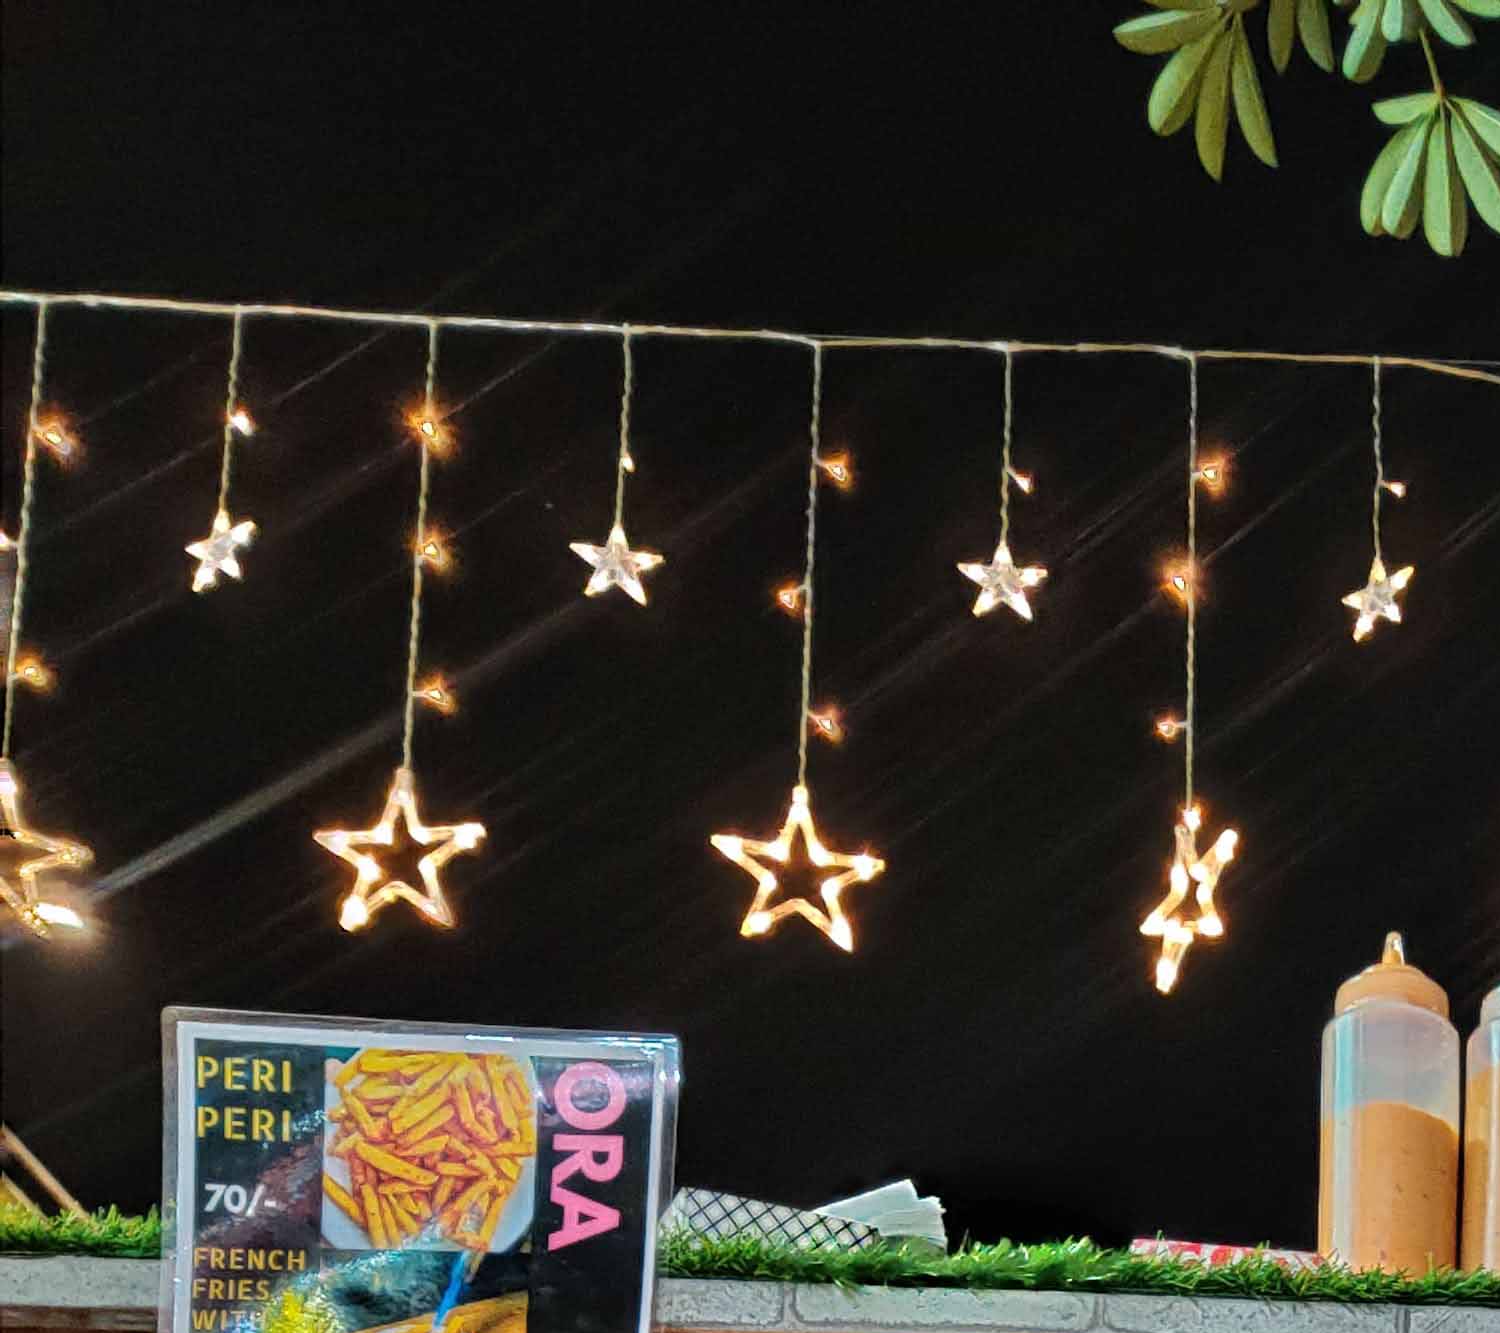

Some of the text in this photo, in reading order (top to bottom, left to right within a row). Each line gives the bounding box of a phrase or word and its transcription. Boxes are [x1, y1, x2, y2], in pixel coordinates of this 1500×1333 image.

[196, 1055, 293, 1094] PERI
[196, 1106, 293, 1142] PERI
[548, 1061, 627, 1252] ORA
[203, 1183, 278, 1217] 70/-
[193, 1247, 306, 1271] FRENCH
[192, 1278, 271, 1301] FRIES
